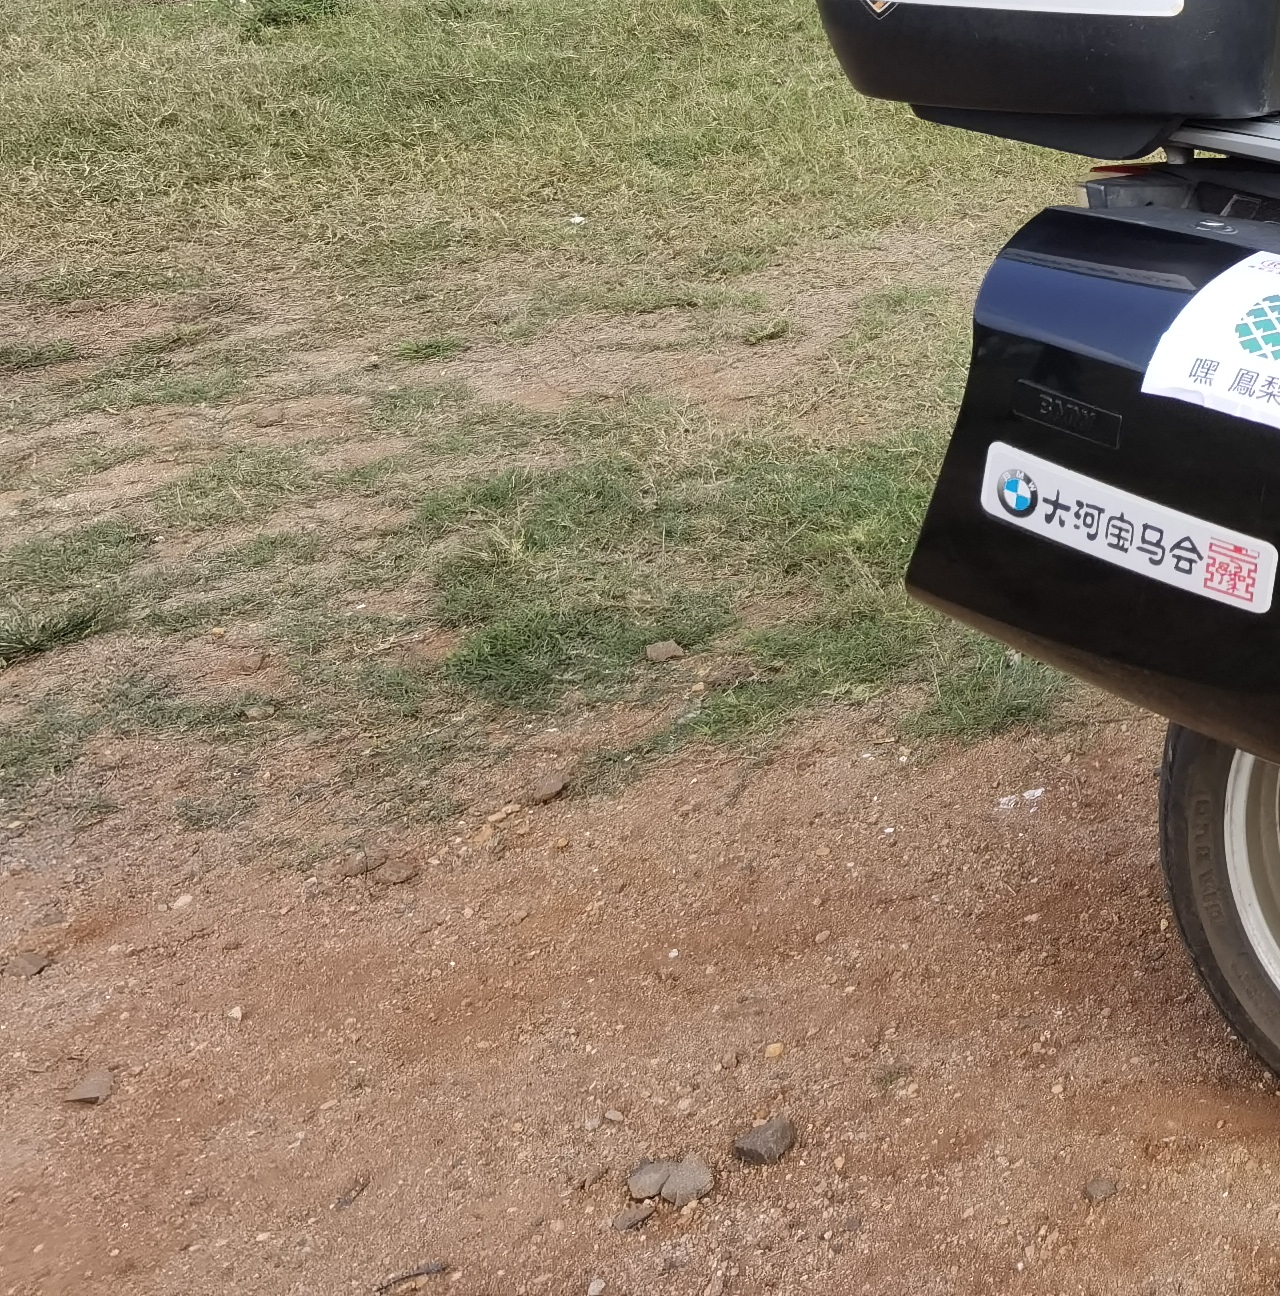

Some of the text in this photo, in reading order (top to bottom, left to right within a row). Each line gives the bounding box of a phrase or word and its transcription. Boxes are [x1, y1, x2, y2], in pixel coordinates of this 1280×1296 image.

[1042, 489, 1203, 575] 大河宝马会
